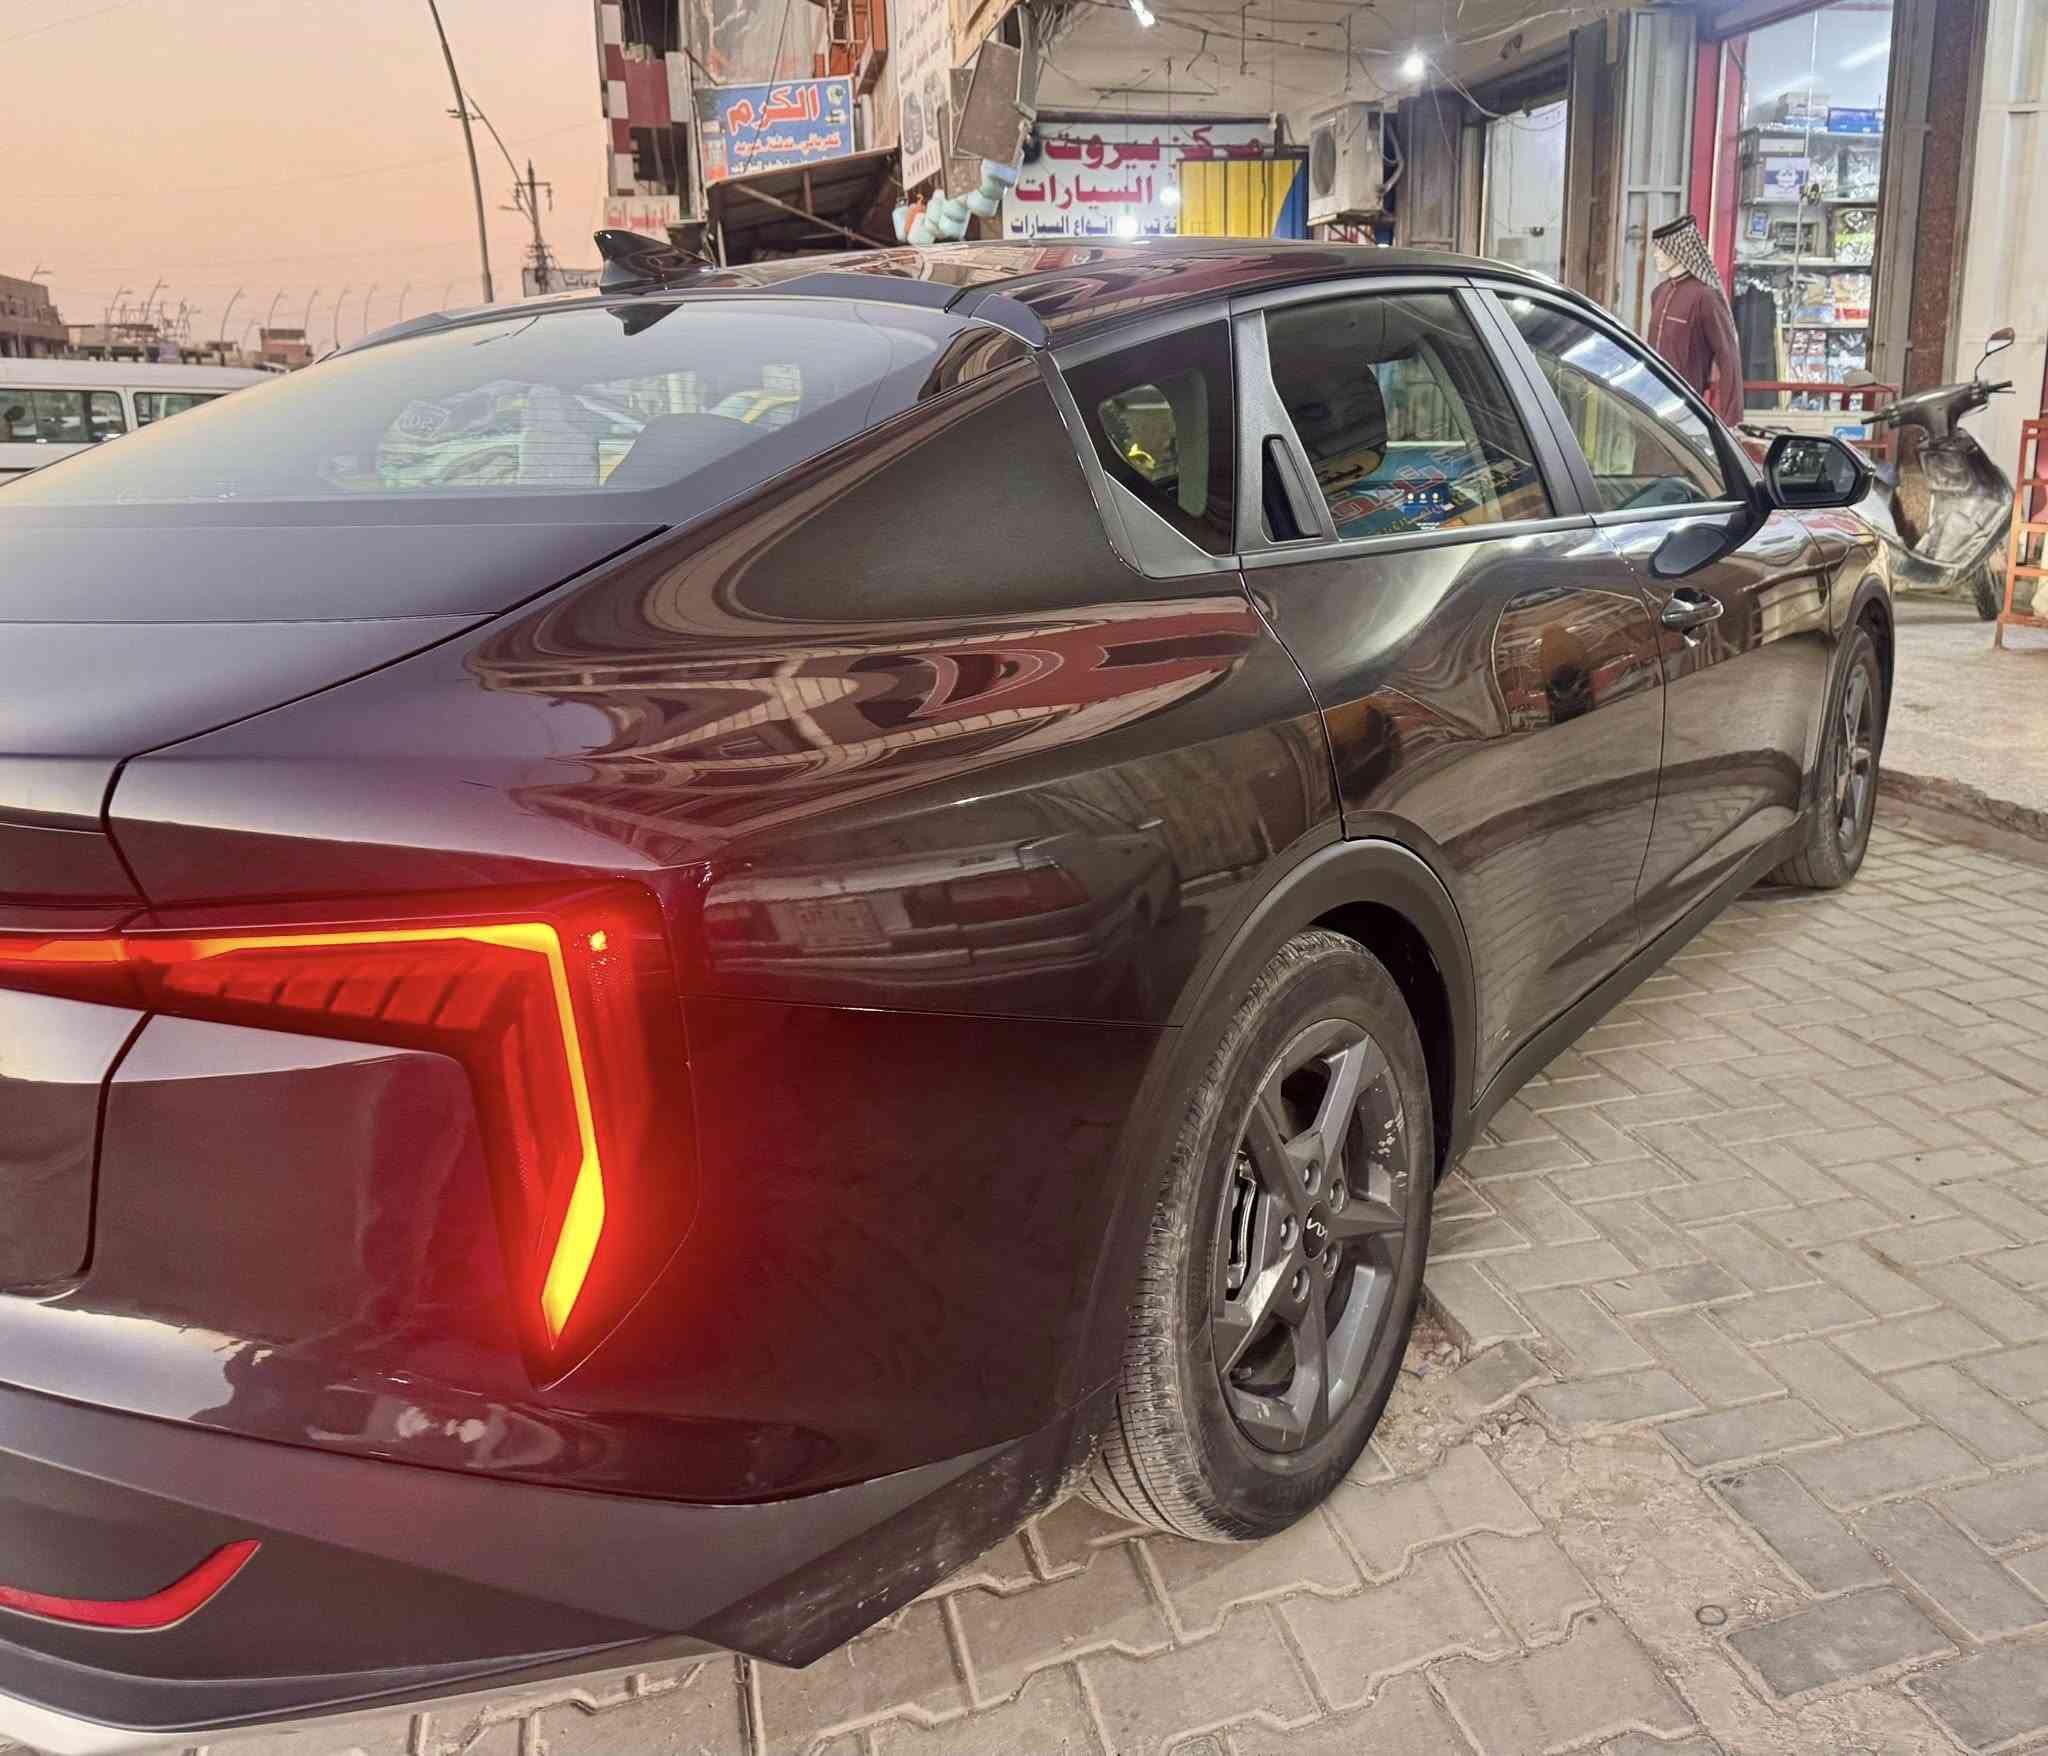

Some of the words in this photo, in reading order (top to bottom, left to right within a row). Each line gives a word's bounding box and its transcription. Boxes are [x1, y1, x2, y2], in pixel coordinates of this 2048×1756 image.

[727, 84, 820, 136] الكرم
[1044, 132, 1161, 170] بيروت
[1015, 174, 1153, 210] السيارات
[1010, 215, 1070, 238] السيارات
